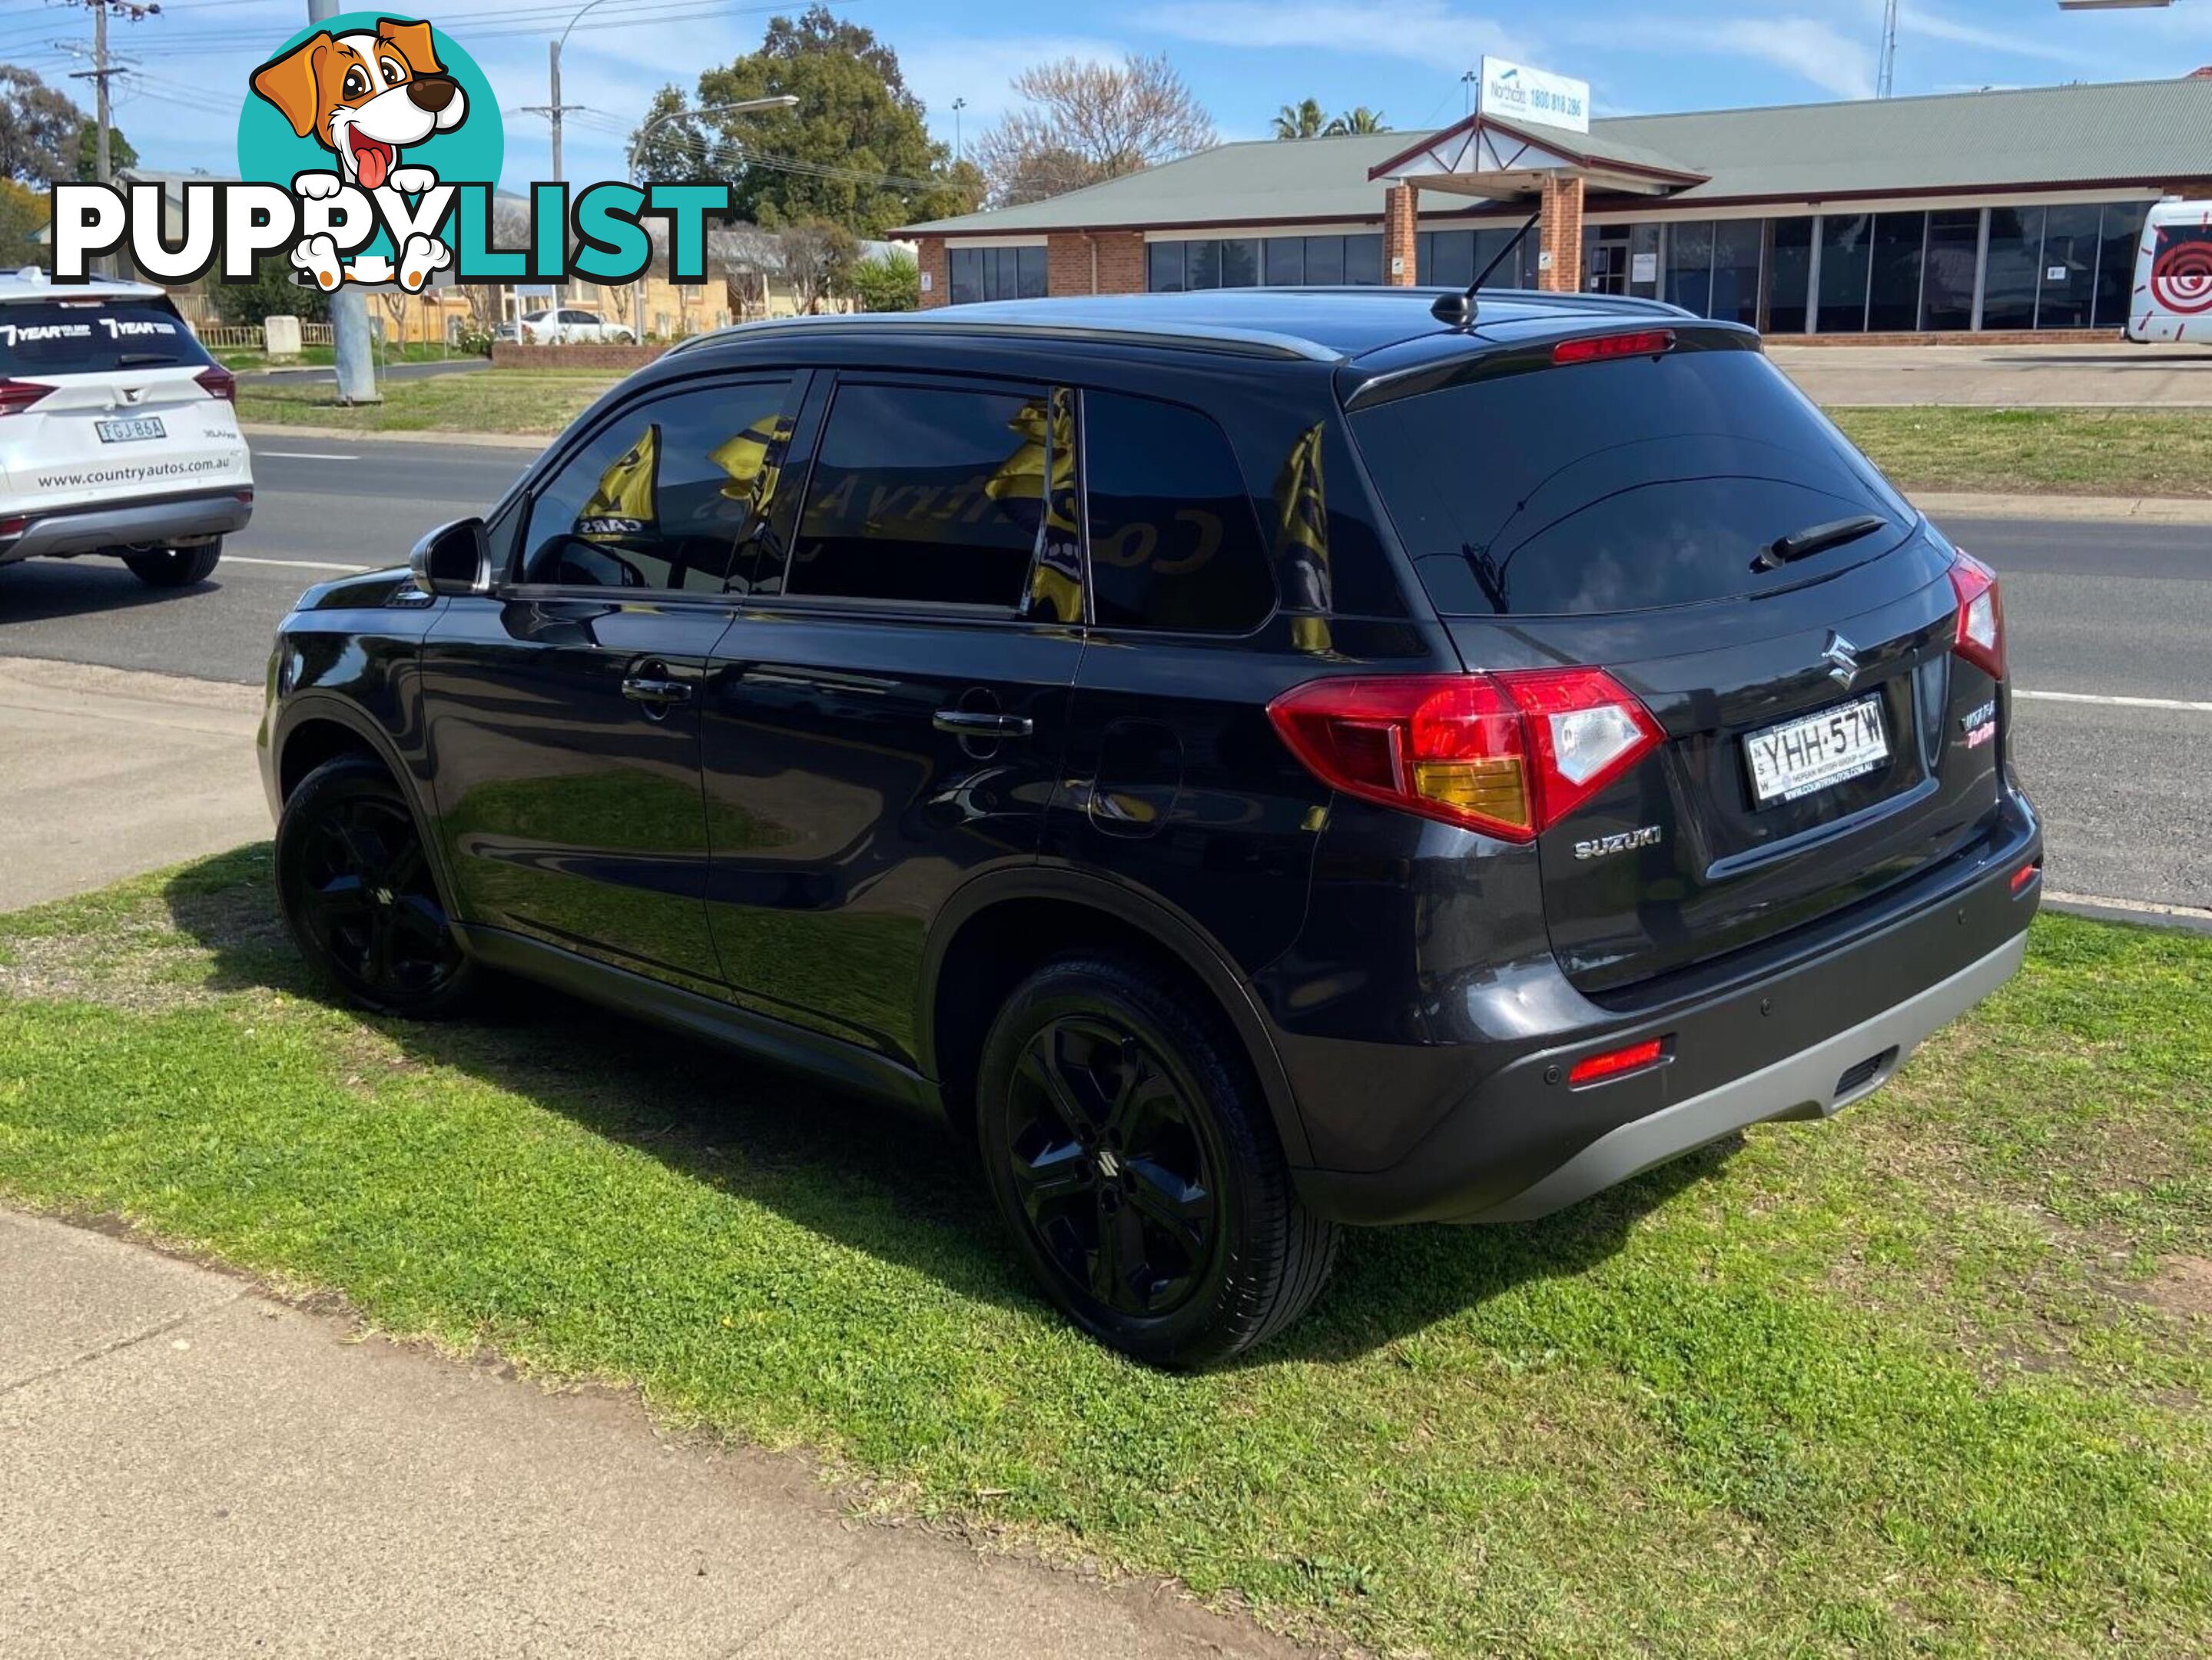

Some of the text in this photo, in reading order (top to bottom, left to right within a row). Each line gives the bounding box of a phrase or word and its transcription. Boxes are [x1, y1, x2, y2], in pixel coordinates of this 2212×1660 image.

[1531, 88, 1550, 109] 1800
[0, 324, 16, 347] 7
[17, 326, 61, 340] YEAR
[98, 318, 118, 339] 7
[118, 322, 154, 335] YEAR
[38, 457, 230, 488] www.countryautos.com.au
[1574, 825, 1661, 860] SUZUKI
